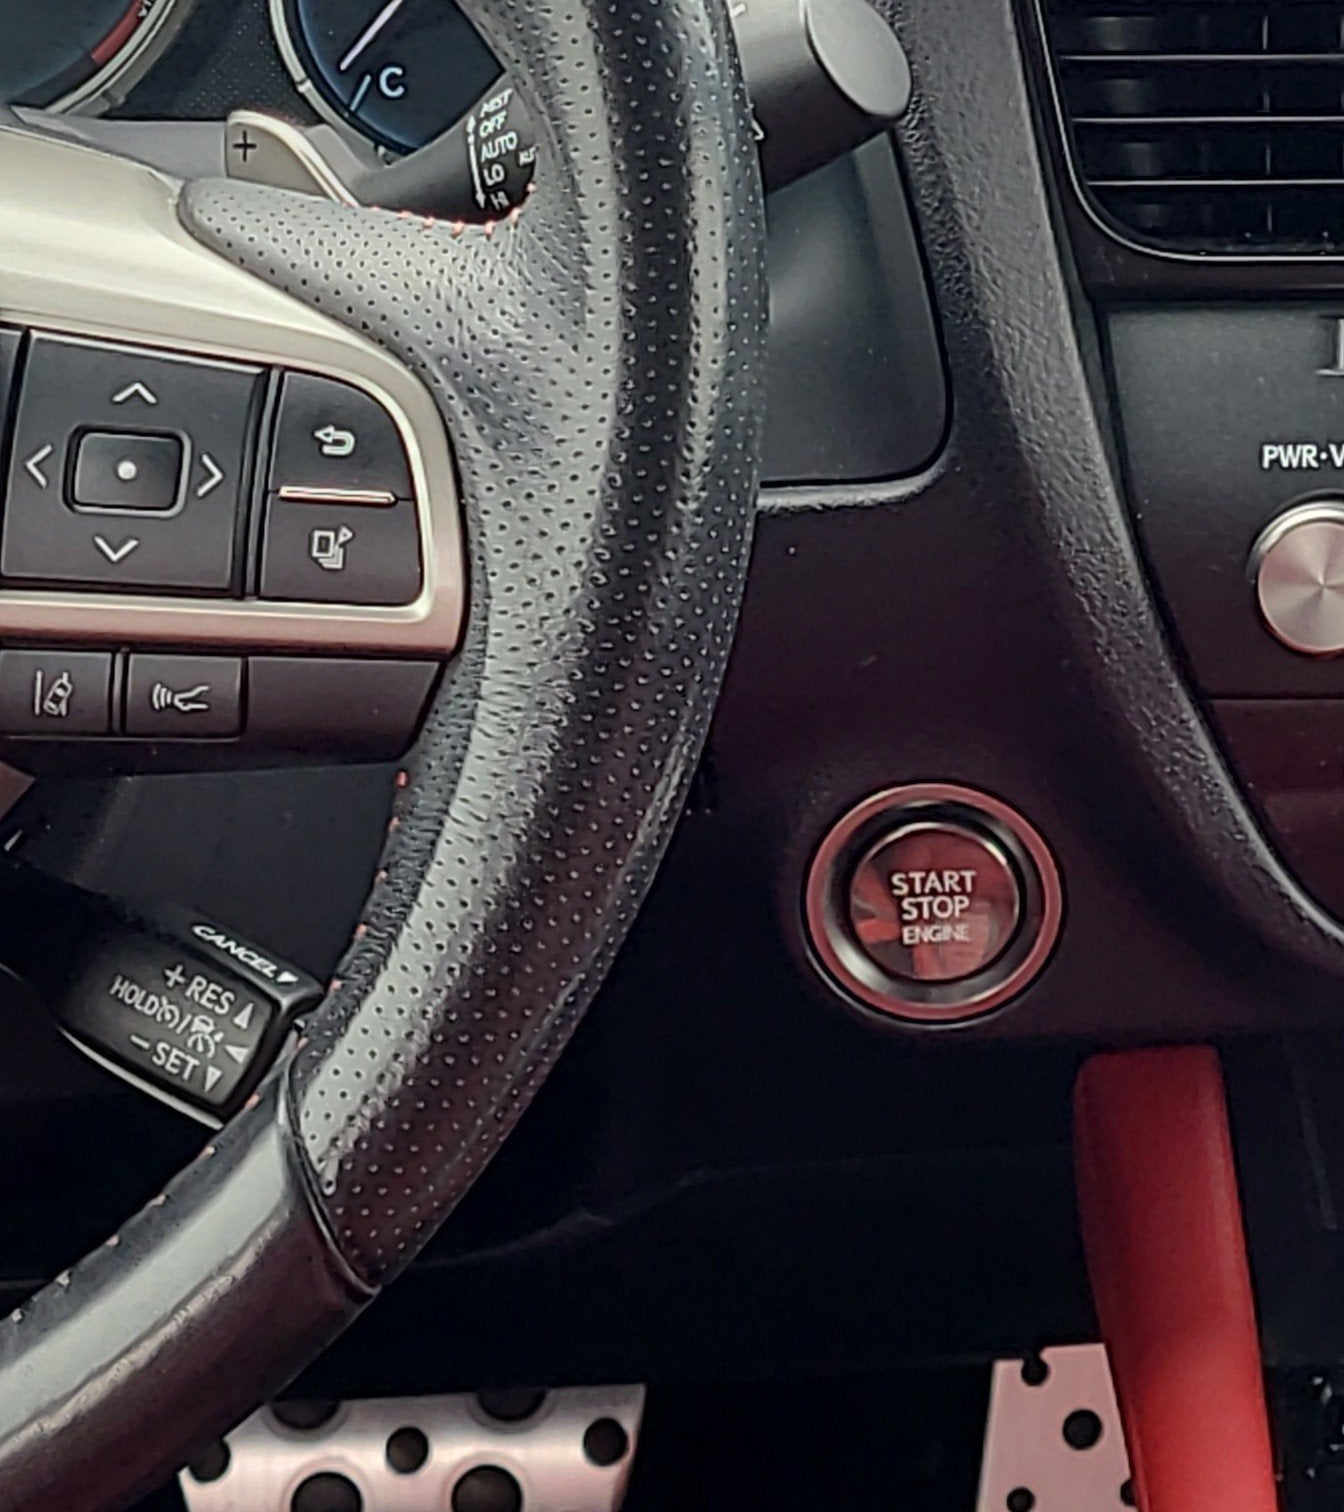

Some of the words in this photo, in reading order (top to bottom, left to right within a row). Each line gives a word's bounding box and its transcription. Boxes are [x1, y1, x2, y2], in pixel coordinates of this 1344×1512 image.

[379, 66, 405, 98] C
[481, 131, 518, 163] AUTO
[483, 163, 505, 186] LO
[891, 869, 977, 896] START
[901, 895, 970, 920] STOP
[902, 925, 971, 945] ENGINE
[191, 925, 279, 979] CANCEL
[109, 974, 160, 1016] HOLD
